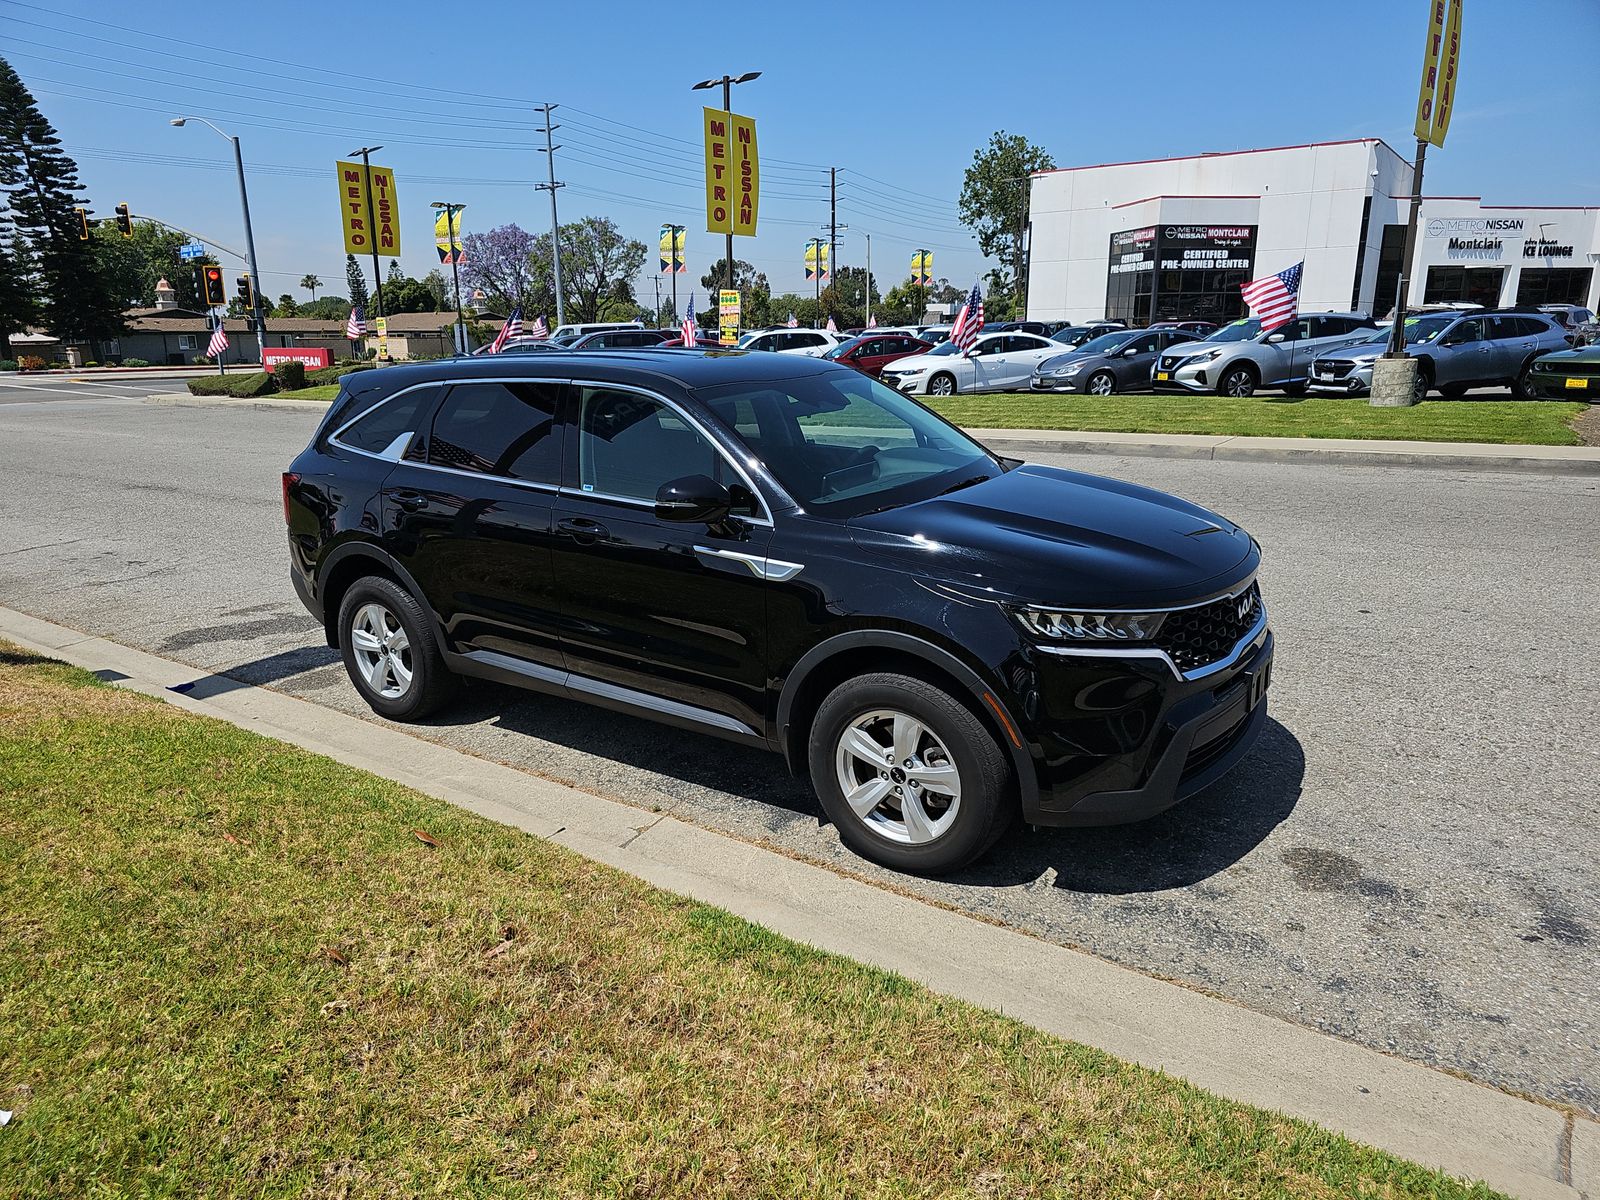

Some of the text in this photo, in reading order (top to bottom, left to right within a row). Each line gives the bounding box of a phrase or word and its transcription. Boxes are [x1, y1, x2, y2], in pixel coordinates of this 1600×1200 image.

[710, 120, 726, 222] METRO
[738, 126, 752, 225] NISSAN
[344, 170, 365, 246] METRO
[374, 174, 394, 248] NISSAN
[1177, 232, 1207, 240] NISSAN
[1207, 228, 1250, 238] MONTCLAIR
[1448, 237, 1503, 250] Montclair
[1183, 249, 1229, 260] CERTIFIED
[1537, 246, 1574, 257] LOUNGE
[1160, 260, 1249, 270] PRE-OWNED CENTER
